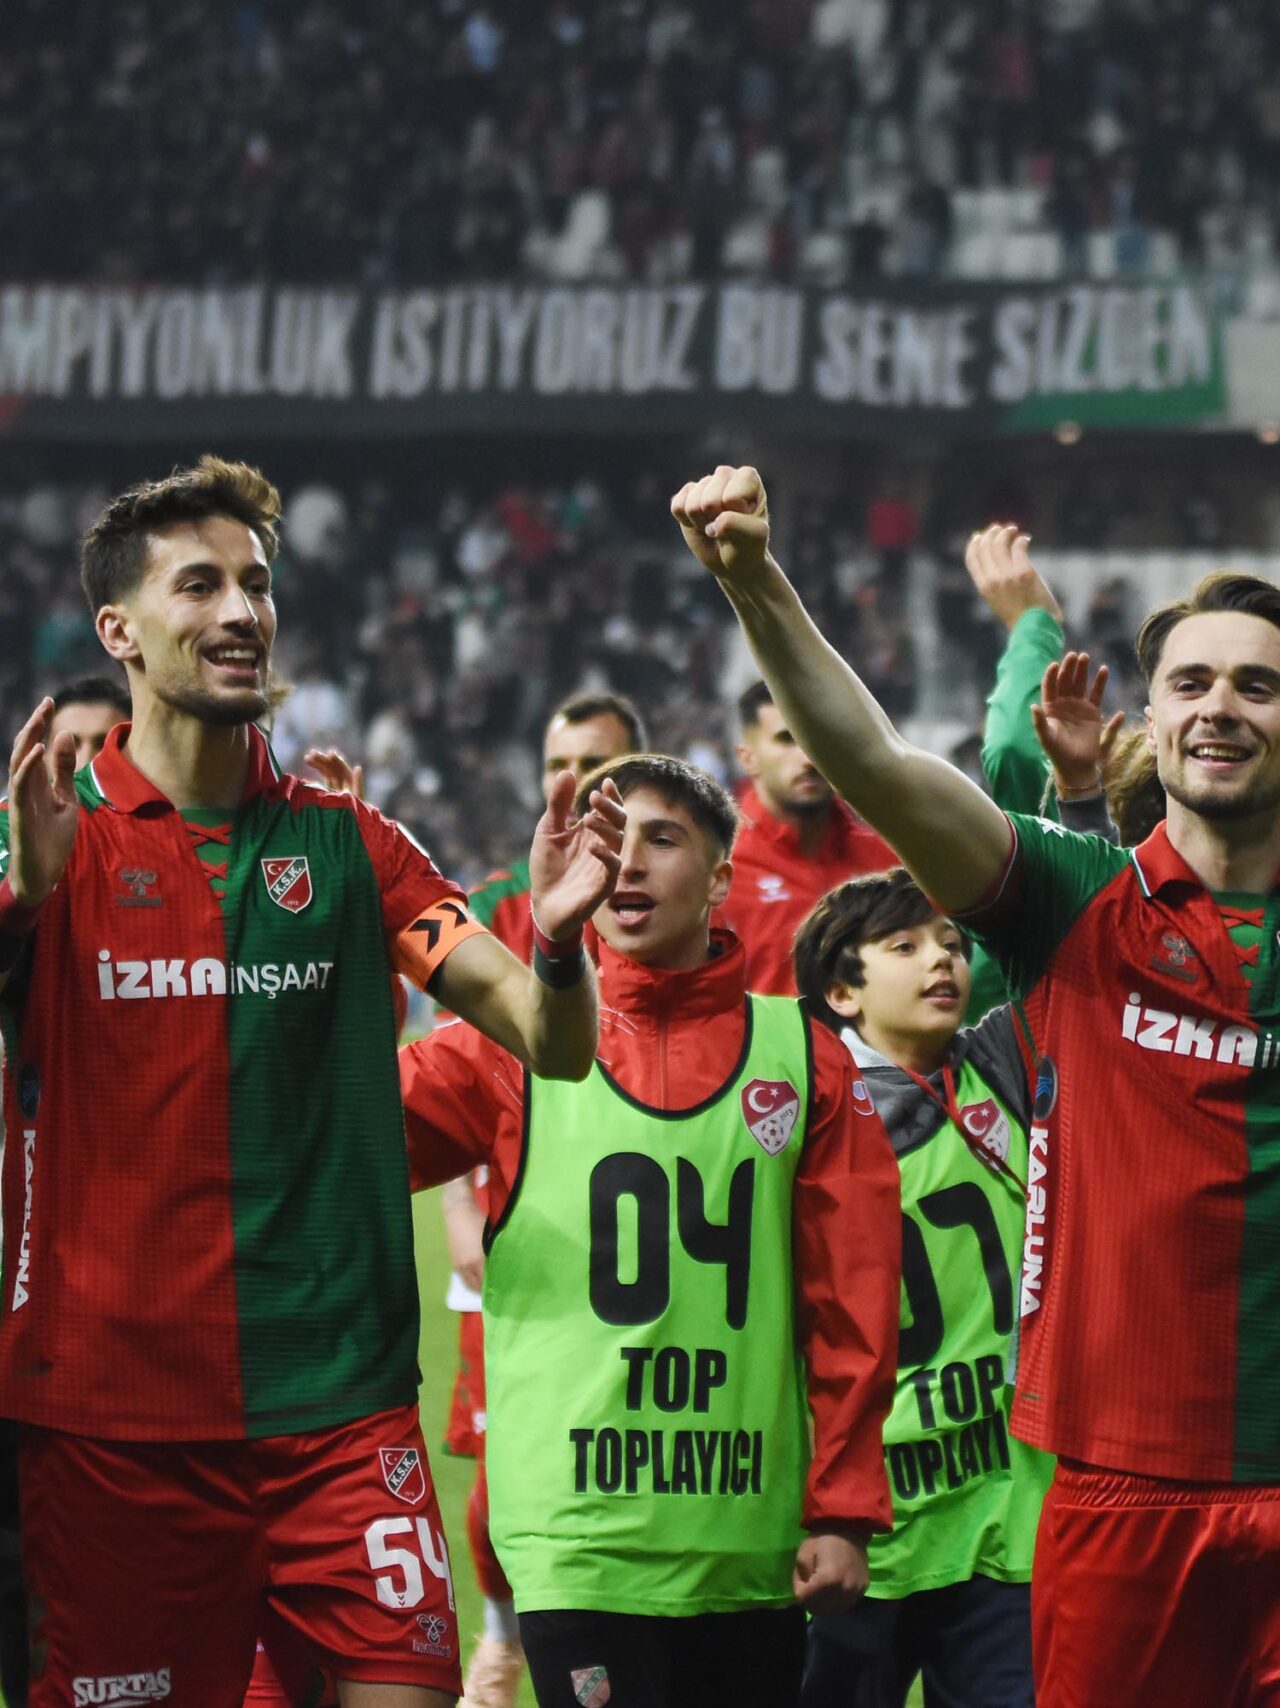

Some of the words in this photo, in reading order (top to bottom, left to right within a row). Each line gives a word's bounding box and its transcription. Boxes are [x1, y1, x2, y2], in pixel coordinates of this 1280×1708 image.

[714, 284, 800, 390] BU
[814, 299, 974, 407] SENE
[273, 866, 302, 896] K.S.K.
[589, 1152, 755, 1331] 04
[1020, 1127, 1049, 1318] KARLUNA
[620, 1346, 727, 1413] TOP
[910, 1354, 1005, 1430] TOP
[390, 1457, 414, 1486] K.S.K.
[569, 1427, 763, 1496] TOPLAYICI
[884, 1408, 1011, 1501] OPLAYI
[364, 1517, 455, 1612] 54
